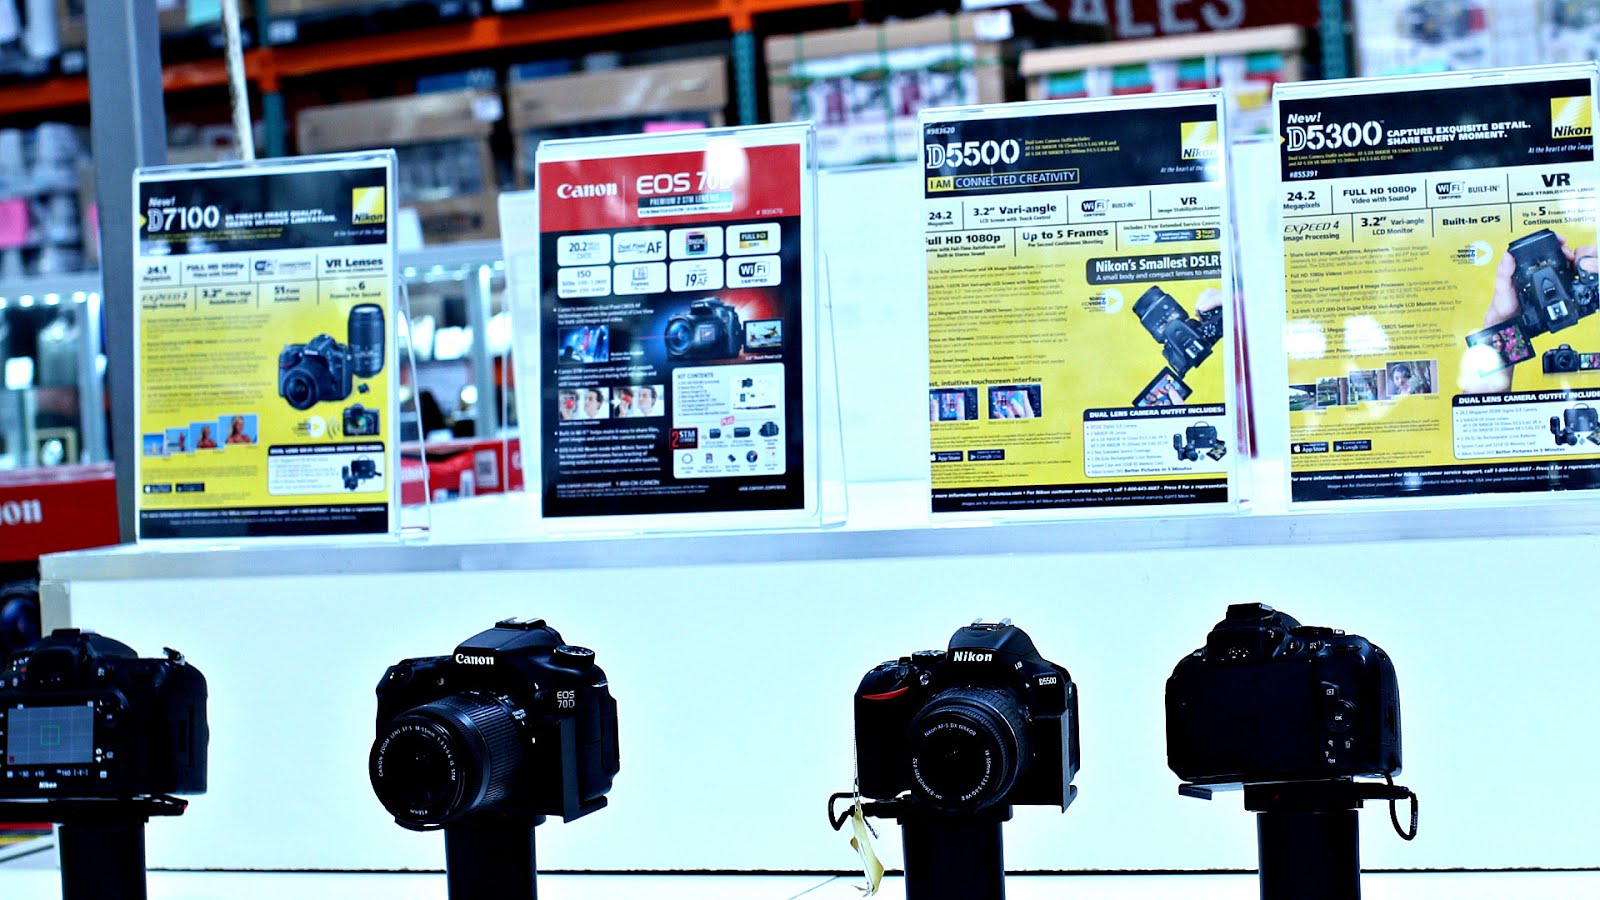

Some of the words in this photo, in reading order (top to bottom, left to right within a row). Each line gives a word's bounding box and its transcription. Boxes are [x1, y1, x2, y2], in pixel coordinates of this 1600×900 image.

[1288, 112, 1321, 124] New!
[1387, 128, 1433, 137] CAPTURE
[1436, 124, 1489, 134] EXQUISITE
[1492, 120, 1531, 130] DETAIL.
[1554, 126, 1591, 137] Nikon
[1287, 120, 1382, 151] D5300
[1388, 136, 1421, 146] SHARE
[1423, 132, 1456, 143] EVERY
[1458, 131, 1508, 141] MOMENT.
[926, 139, 1020, 169] D5500
[636, 172, 691, 194] EOS
[936, 180, 951, 189] AM
[956, 175, 1016, 188] CONNECTED
[1020, 172, 1076, 184] CREATIVITY
[1542, 173, 1571, 188] VR
[557, 182, 618, 199] Canon
[1343, 188, 1367, 197] FULL
[1388, 186, 1417, 194] 1080p
[650, 196, 676, 206] PREMIUM
[1180, 196, 1198, 206] VR
[1287, 191, 1316, 202] 24.2
[1000, 204, 1057, 215] Vari-angle
[1283, 202, 1321, 210] Megapixels
[1538, 206, 1546, 216] 5
[147, 205, 220, 232] D7100
[354, 213, 384, 223] Nikon
[929, 212, 952, 221] 24.2
[1442, 218, 1478, 226] Built-In
[1481, 216, 1501, 224] GPS
[1333, 220, 1340, 229] 4
[1391, 218, 1424, 226] Vari-angle
[1524, 218, 1562, 226] Continuous
[1022, 232, 1037, 242] Up
[1042, 230, 1053, 239] to
[1057, 230, 1064, 238] 5
[1067, 228, 1109, 238] Frames
[1196, 230, 1202, 240] 3
[1305, 232, 1340, 240] Processing
[1372, 228, 1385, 236] LCD
[1387, 227, 1413, 235] Monitor
[926, 236, 942, 245] ull
[946, 236, 962, 244] HD
[966, 234, 1001, 244] 1080p
[569, 242, 587, 253] 20.2
[647, 241, 663, 254] AF
[326, 259, 342, 268] VR
[346, 258, 383, 267] Lenses
[1096, 259, 1137, 273] Nikon's
[1140, 256, 1187, 270] Smallest
[577, 270, 592, 278] ISO
[1120, 272, 1135, 280] body
[1149, 271, 1174, 280] compact
[686, 274, 697, 287] 19
[358, 281, 366, 291] 6
[972, 378, 1012, 386] touchscreen
[1012, 376, 1043, 384] interface
[1458, 397, 1480, 405] DUAL
[1504, 394, 1536, 402] CAMERA
[1538, 393, 1567, 401] OUTFIT
[679, 430, 696, 439] STM
[455, 653, 495, 666] Canon
[953, 652, 993, 662] Nikon
[1038, 676, 1057, 686] D5500
[556, 690, 575, 700] EOS
[557, 700, 575, 709] 70D
[924, 726, 938, 738] Nikon
[958, 724, 977, 737] NIKKOR
